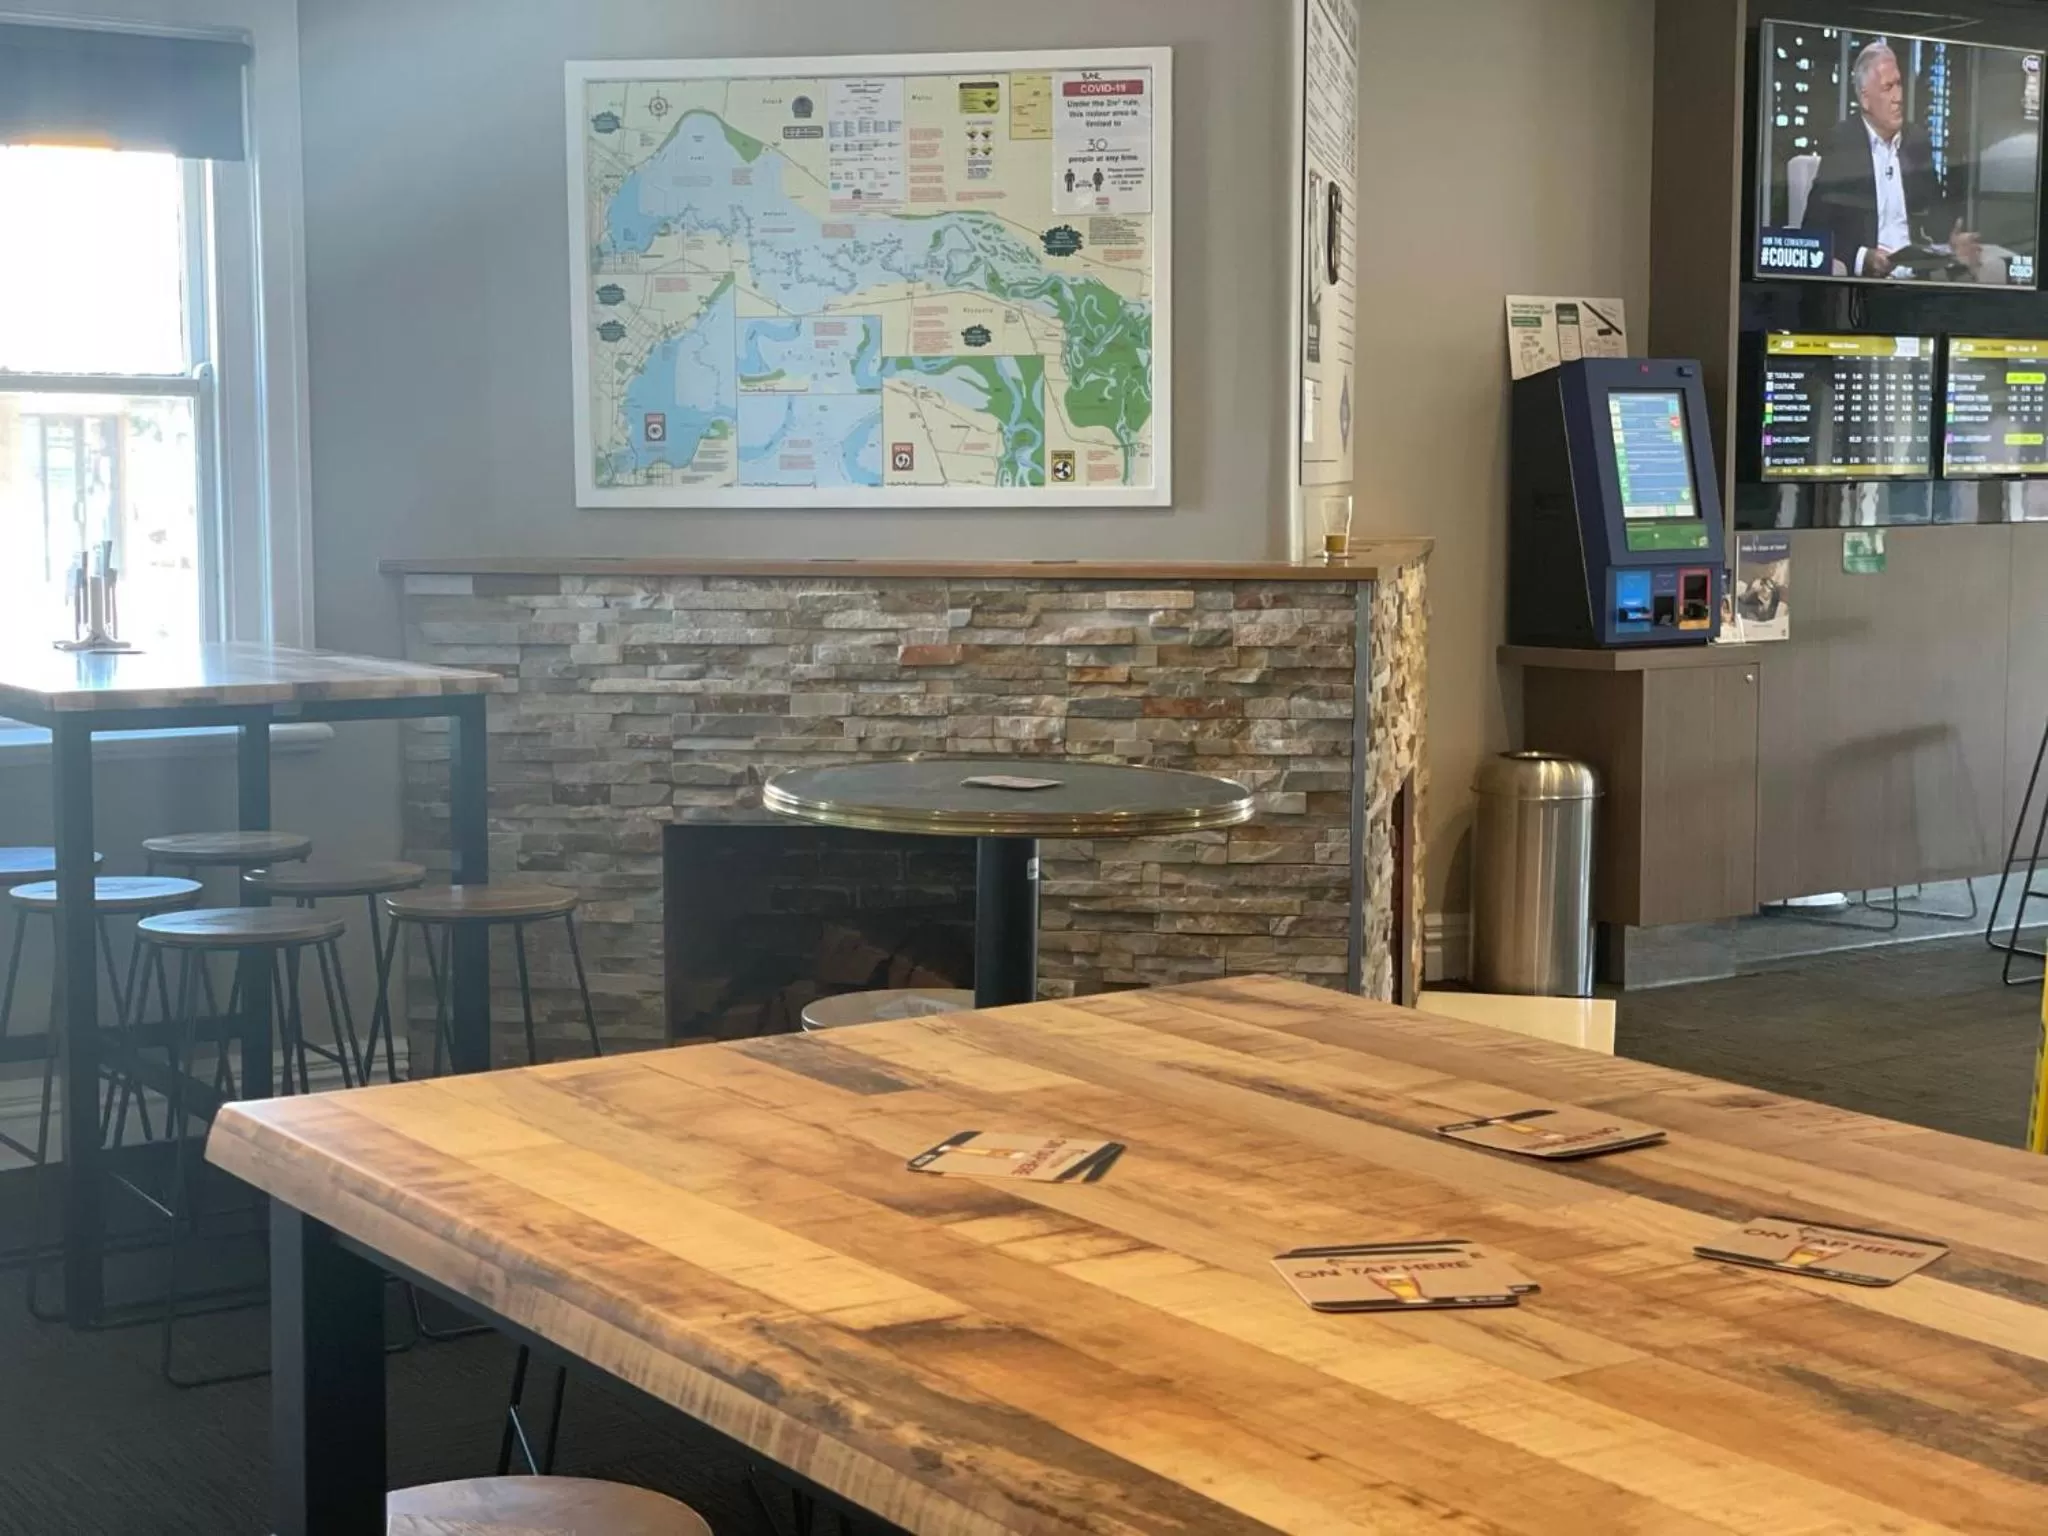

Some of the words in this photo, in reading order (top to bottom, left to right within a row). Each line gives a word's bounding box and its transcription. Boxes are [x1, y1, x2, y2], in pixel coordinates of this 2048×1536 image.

[1080, 83, 1126, 93] COVID-19
[1067, 100, 1090, 108] Under
[1068, 156, 1095, 164] people
[1105, 155, 1119, 163] any
[1761, 246, 1808, 267] #COUCH
[1743, 1228, 1789, 1241] ON
[1799, 1235, 1849, 1249] TAP
[1851, 1243, 1927, 1259] HERE
[1294, 1268, 1342, 1279] ON
[1344, 1263, 1396, 1275] TAP
[1401, 1259, 1472, 1272] HERE
